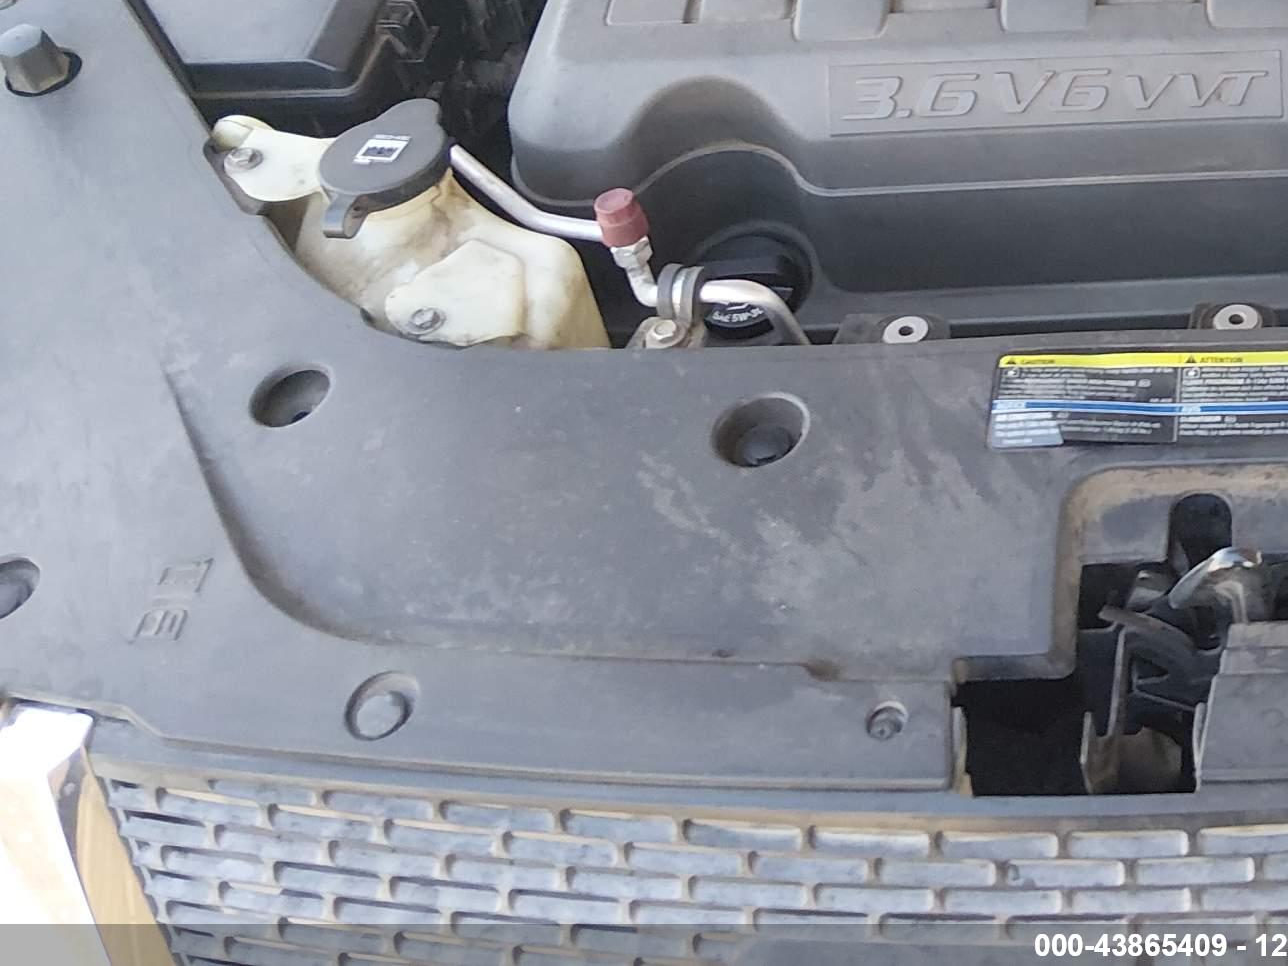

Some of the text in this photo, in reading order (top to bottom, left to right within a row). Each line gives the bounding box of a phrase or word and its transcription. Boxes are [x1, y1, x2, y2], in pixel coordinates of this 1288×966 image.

[840, 68, 1268, 121] 3.6 V6 VVT
[712, 310, 730, 322] SAE
[1200, 356, 1243, 364] ATTENTION
